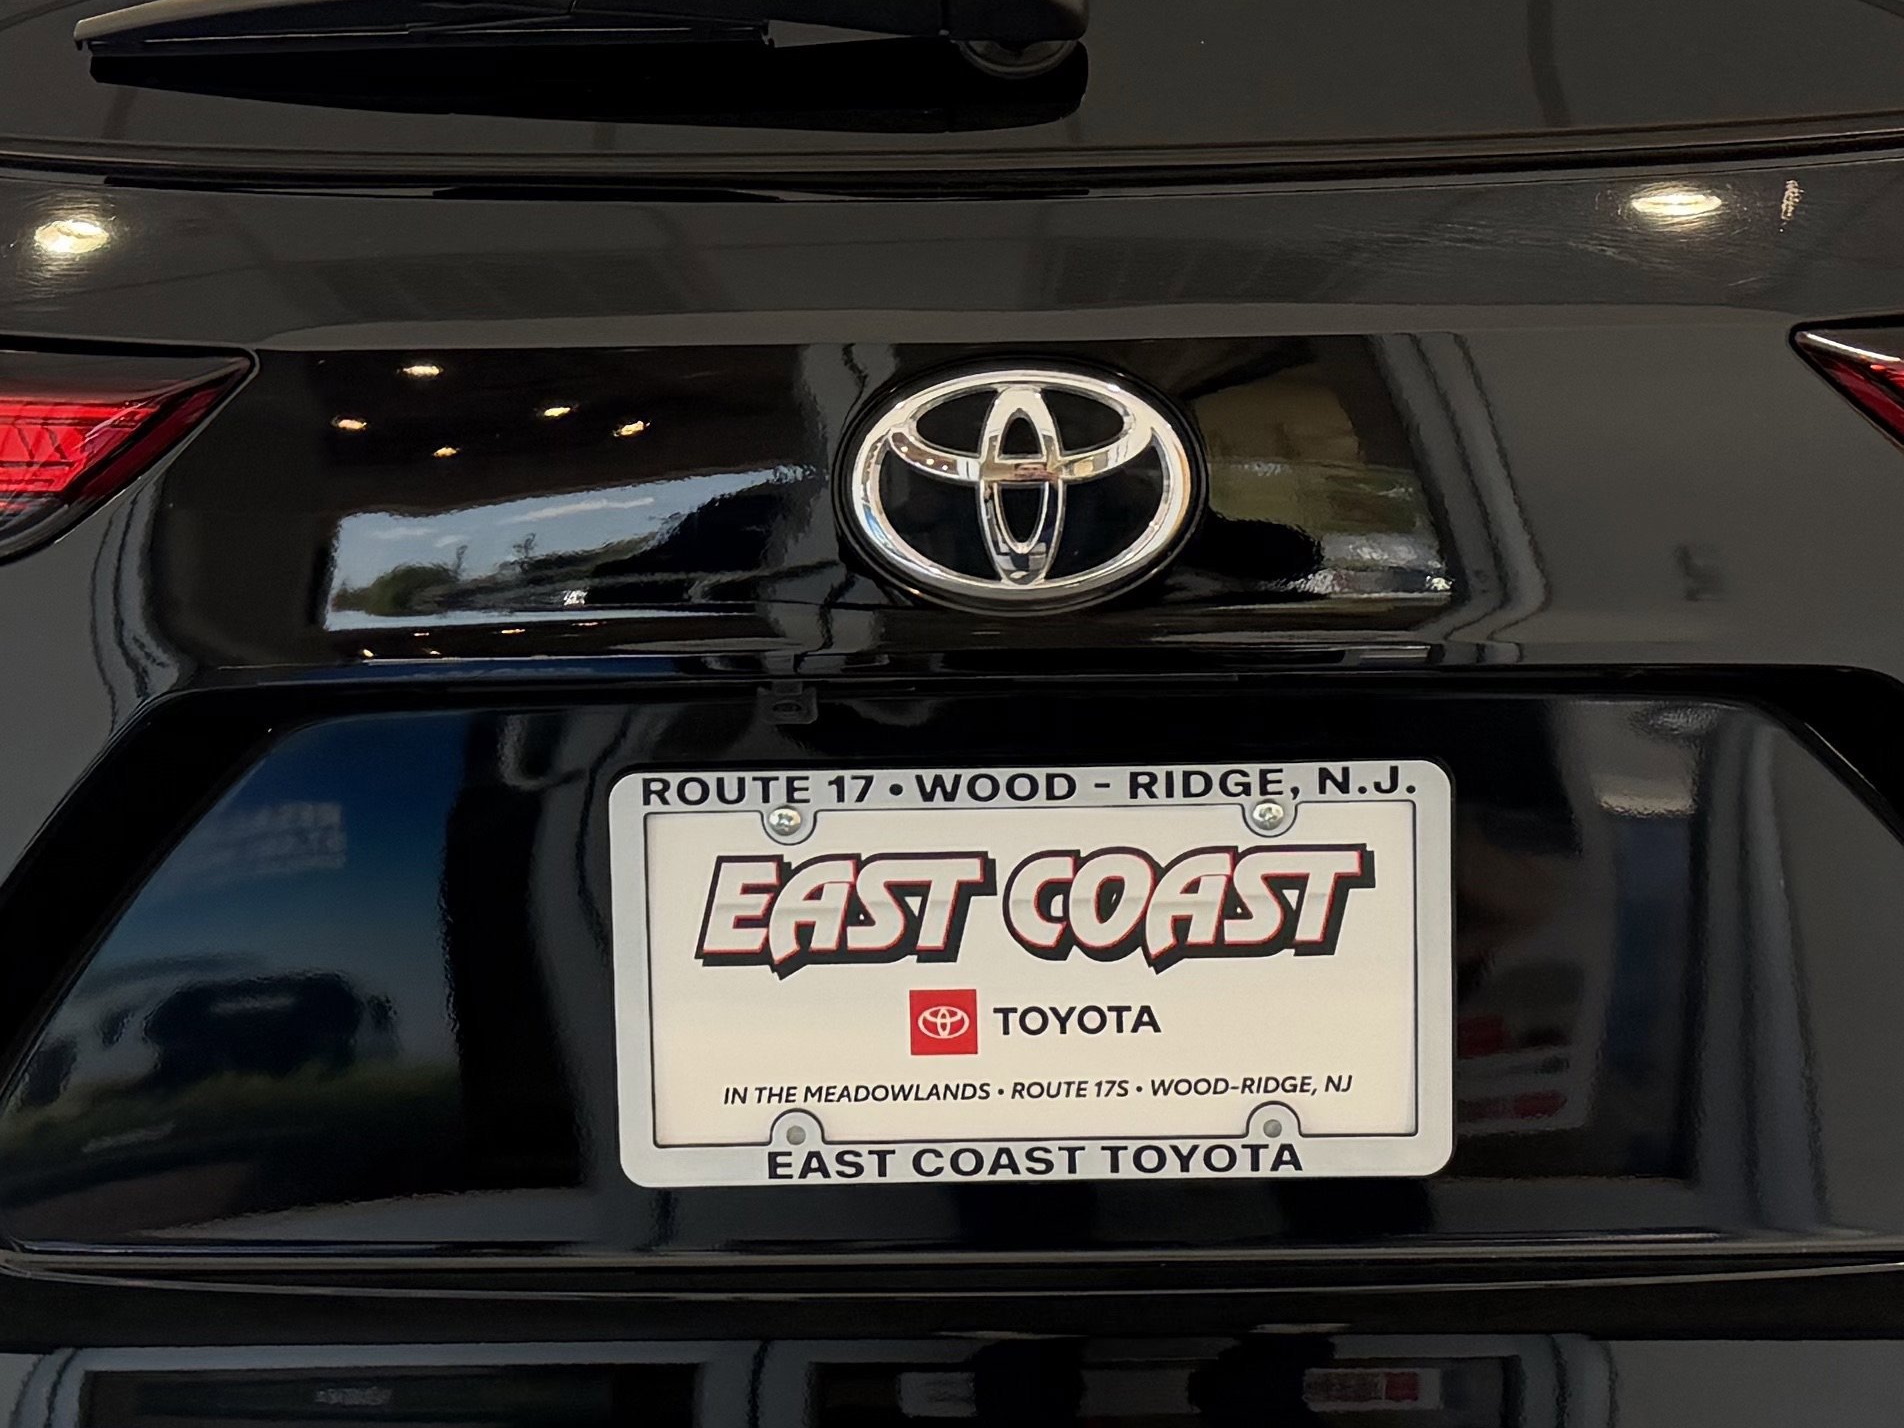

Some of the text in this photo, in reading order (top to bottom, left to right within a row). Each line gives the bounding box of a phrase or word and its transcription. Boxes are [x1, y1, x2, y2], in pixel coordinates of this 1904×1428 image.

[640, 776, 812, 807] ROUTE
[827, 773, 874, 804] 17
[916, 771, 1077, 803] WOOD
[1127, 767, 1303, 801] RIDGE,
[1317, 764, 1419, 797] N.J.
[694, 843, 1377, 980] EAST COAST
[992, 1004, 1163, 1038] TOYOTA
[722, 1073, 1354, 1105] IN THE MEADOWLANDS ROUTE 17S WOOD-RIDGE, NJ
[766, 1142, 1304, 1182] EAST COAST TOYOTA
